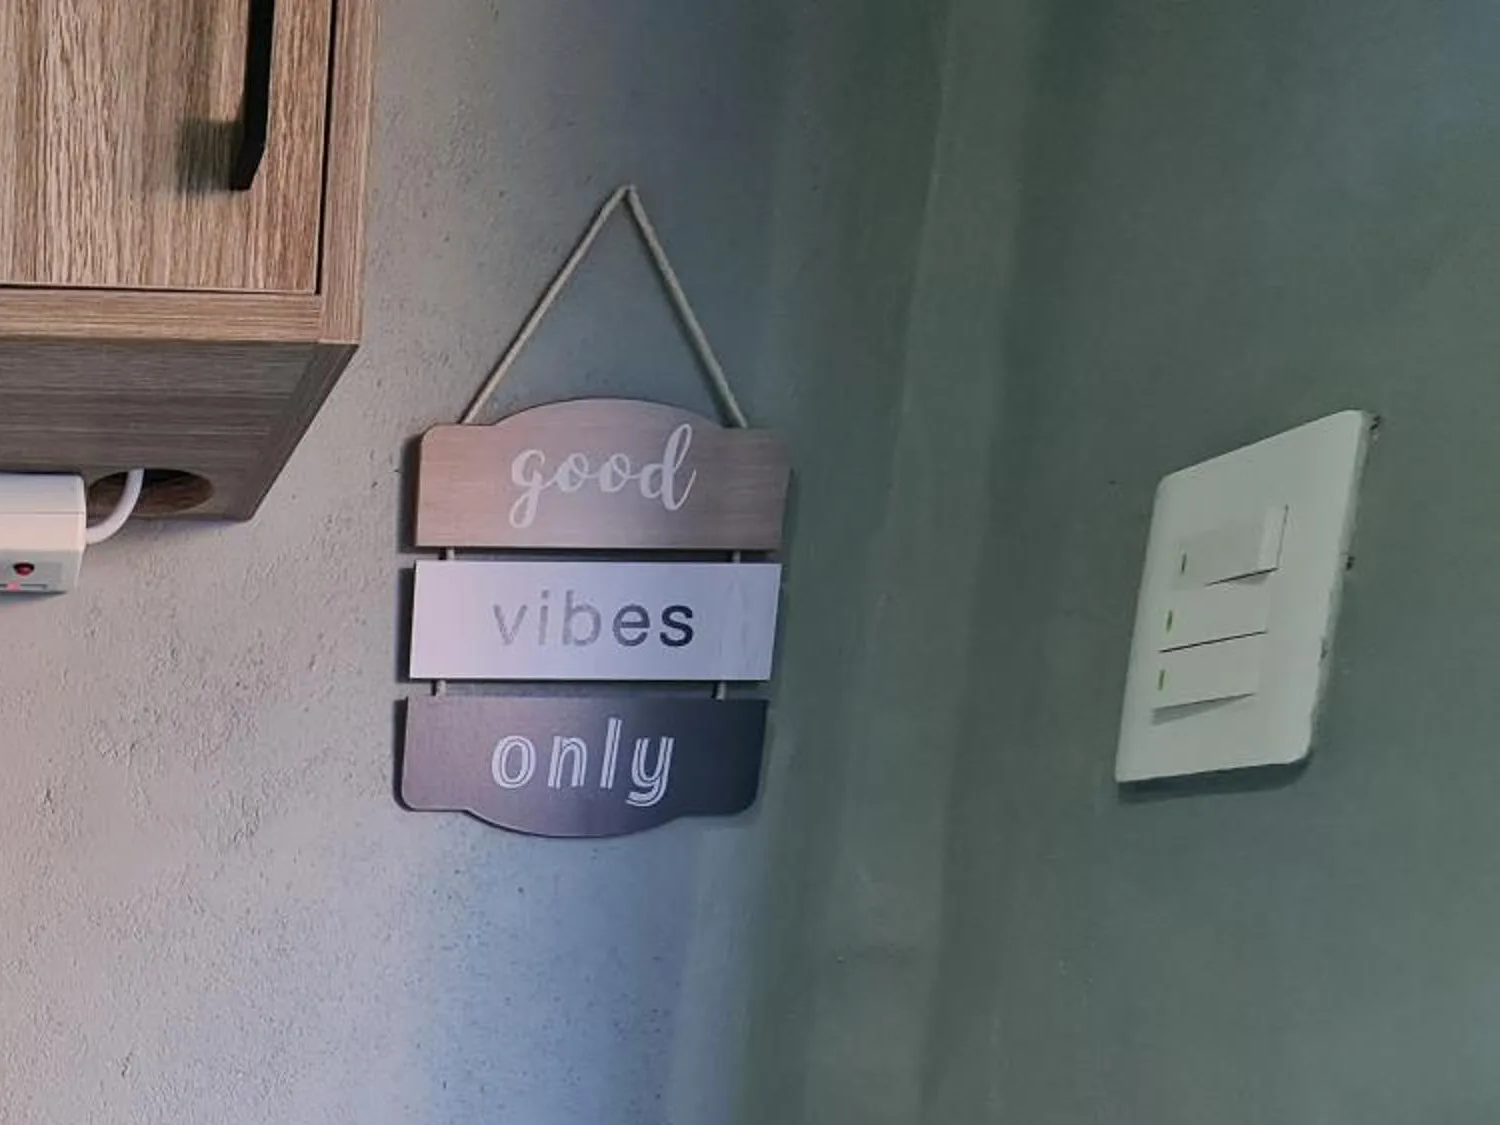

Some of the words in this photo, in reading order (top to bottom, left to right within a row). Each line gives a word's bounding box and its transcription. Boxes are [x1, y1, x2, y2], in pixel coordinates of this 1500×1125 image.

[509, 423, 697, 530] good
[493, 588, 695, 648] vibes
[491, 716, 676, 808] only
